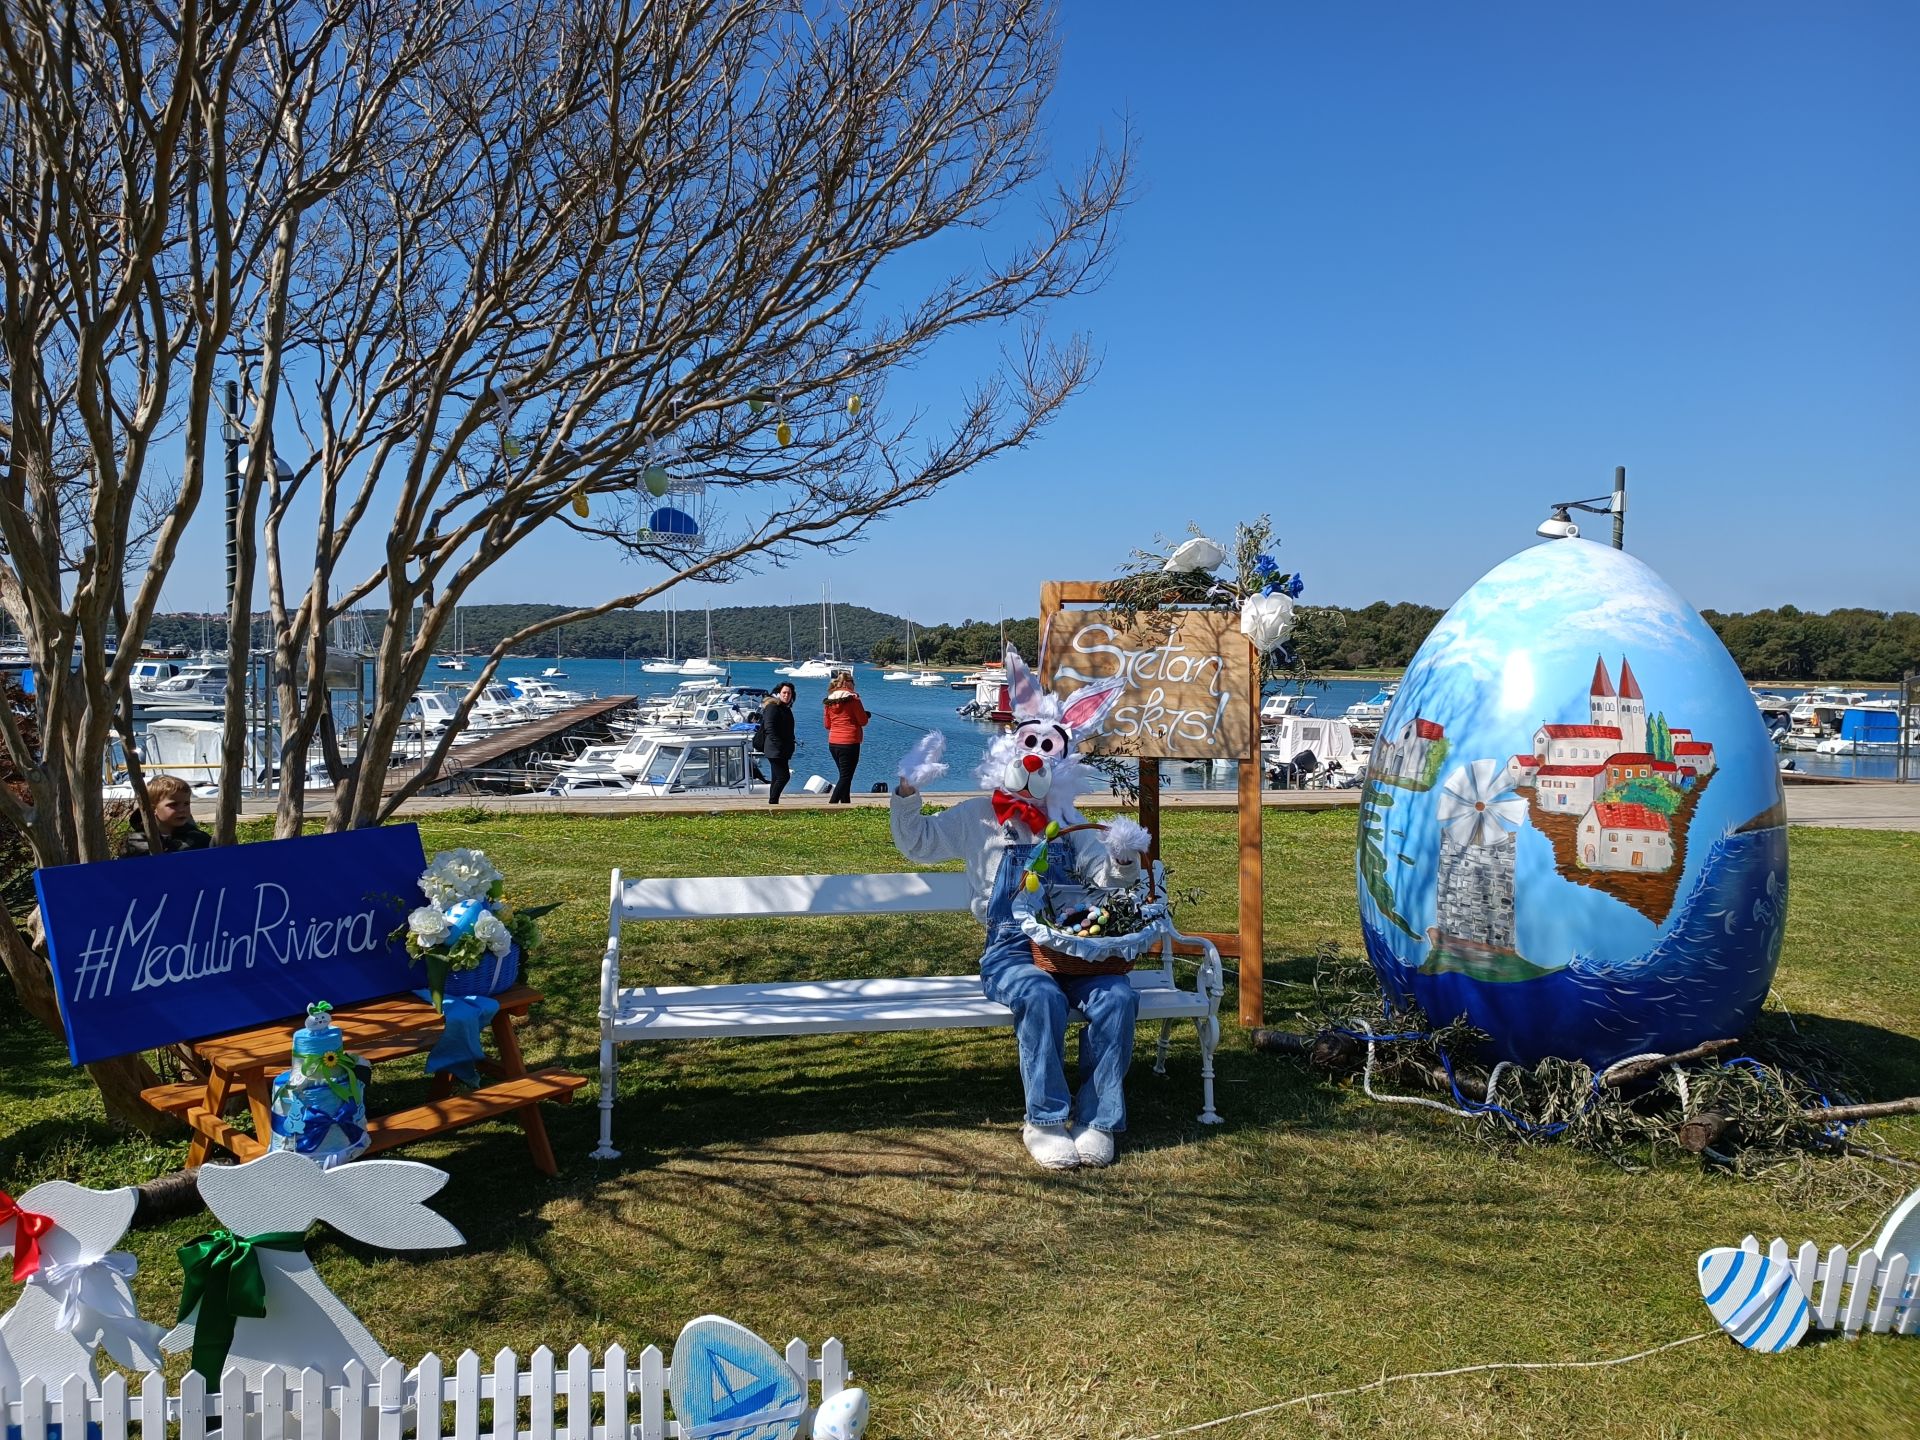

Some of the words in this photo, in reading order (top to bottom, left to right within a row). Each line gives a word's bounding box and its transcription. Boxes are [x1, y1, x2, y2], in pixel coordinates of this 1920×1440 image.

[1054, 623, 1223, 696] Sretan
[1099, 687, 1230, 750] skrs!
[73, 882, 378, 1001] #MedulinRiviera
